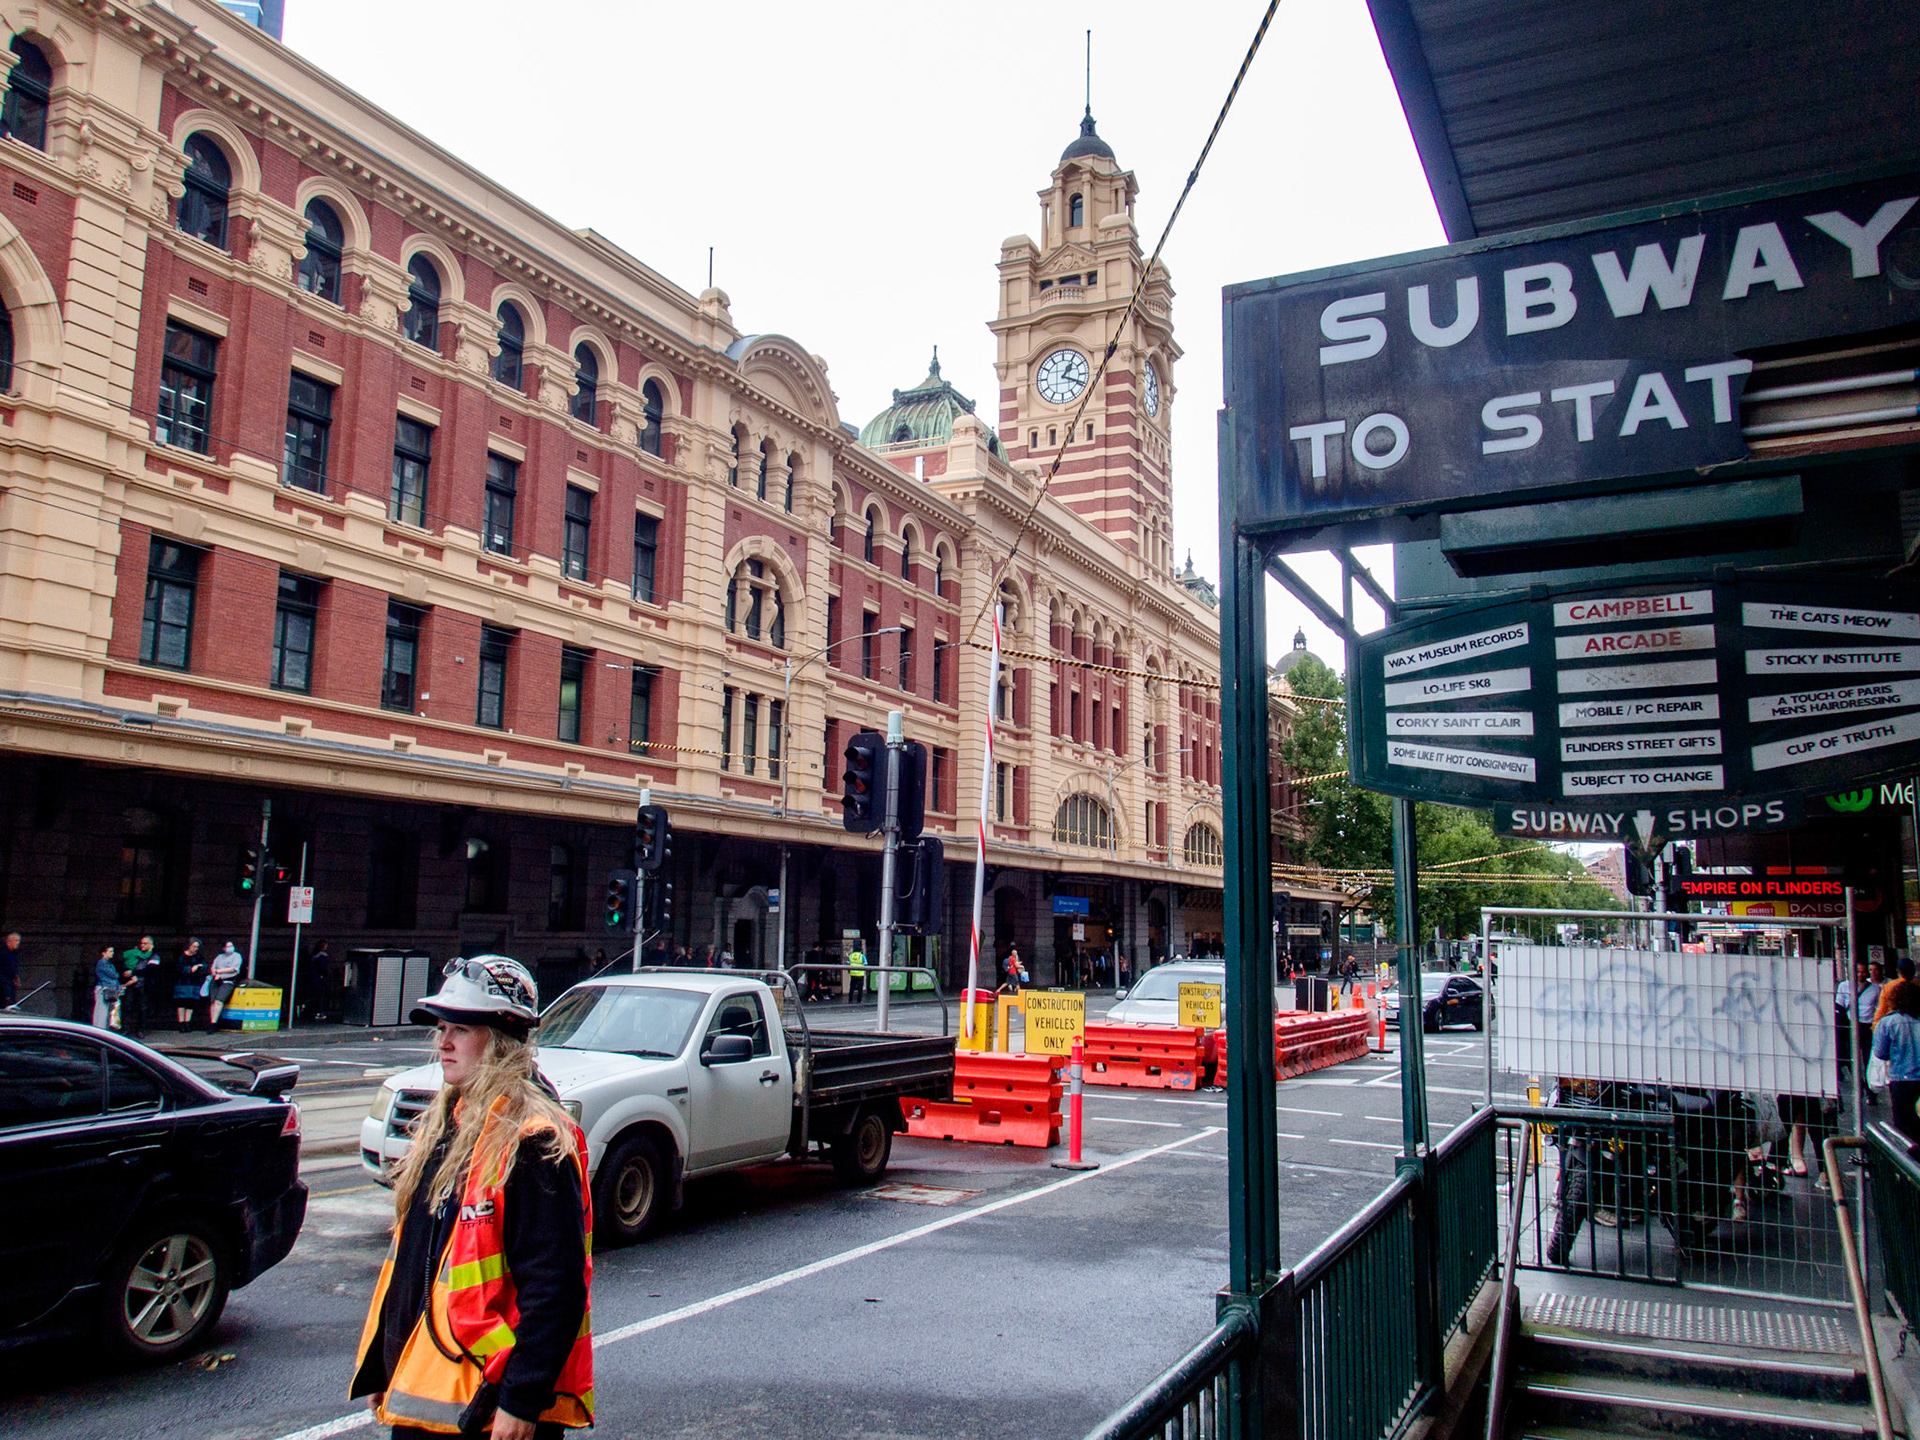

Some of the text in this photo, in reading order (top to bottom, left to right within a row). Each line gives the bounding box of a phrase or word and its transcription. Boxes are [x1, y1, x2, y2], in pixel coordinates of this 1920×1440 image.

[1318, 196, 1920, 366] SUBWAY
[1289, 357, 1754, 479] TO STAT
[1569, 596, 1693, 620] CAMPBELL
[1770, 608, 1892, 628] THE CATS MEOW
[1388, 628, 1524, 669] WAX MUSEUM RECORDS
[1584, 631, 1682, 653] ARCADE
[1765, 652, 1902, 666] STICKY INSTITUTE
[1423, 678, 1491, 695] LO-LIFE SK8
[1777, 684, 1893, 706] A TOUCH OF PARIS
[1575, 705, 1624, 719] MOBILE
[1635, 703, 1654, 715] PC
[1656, 701, 1704, 714] REPAIR
[1771, 694, 1901, 717] MEN'S HAIRDRESSING
[1396, 717, 1522, 728] CORKY SAINT CLAIR
[1565, 736, 1716, 754] FLINDERS STREET GIFTS
[1786, 724, 1896, 756] CUP OF TRUTH
[1393, 747, 1530, 774] SOME LIKE IT HOT CONSIGNMENT
[1570, 771, 1714, 788] SUBJECT TO CHANGE
[1511, 801, 1784, 834] SUBWAY SHOPS
[1681, 881, 1843, 895] EMPIRE ON FLINDERS
[1790, 903, 1845, 913] DAISO
[1027, 997, 1084, 1012] CONSTRUCTION
[1185, 1000, 1214, 1011] VEHICLES
[1035, 1017, 1076, 1031] VEHICLES
[1191, 1013, 1207, 1023] ONLY
[1044, 1036, 1065, 1049] ONLY
